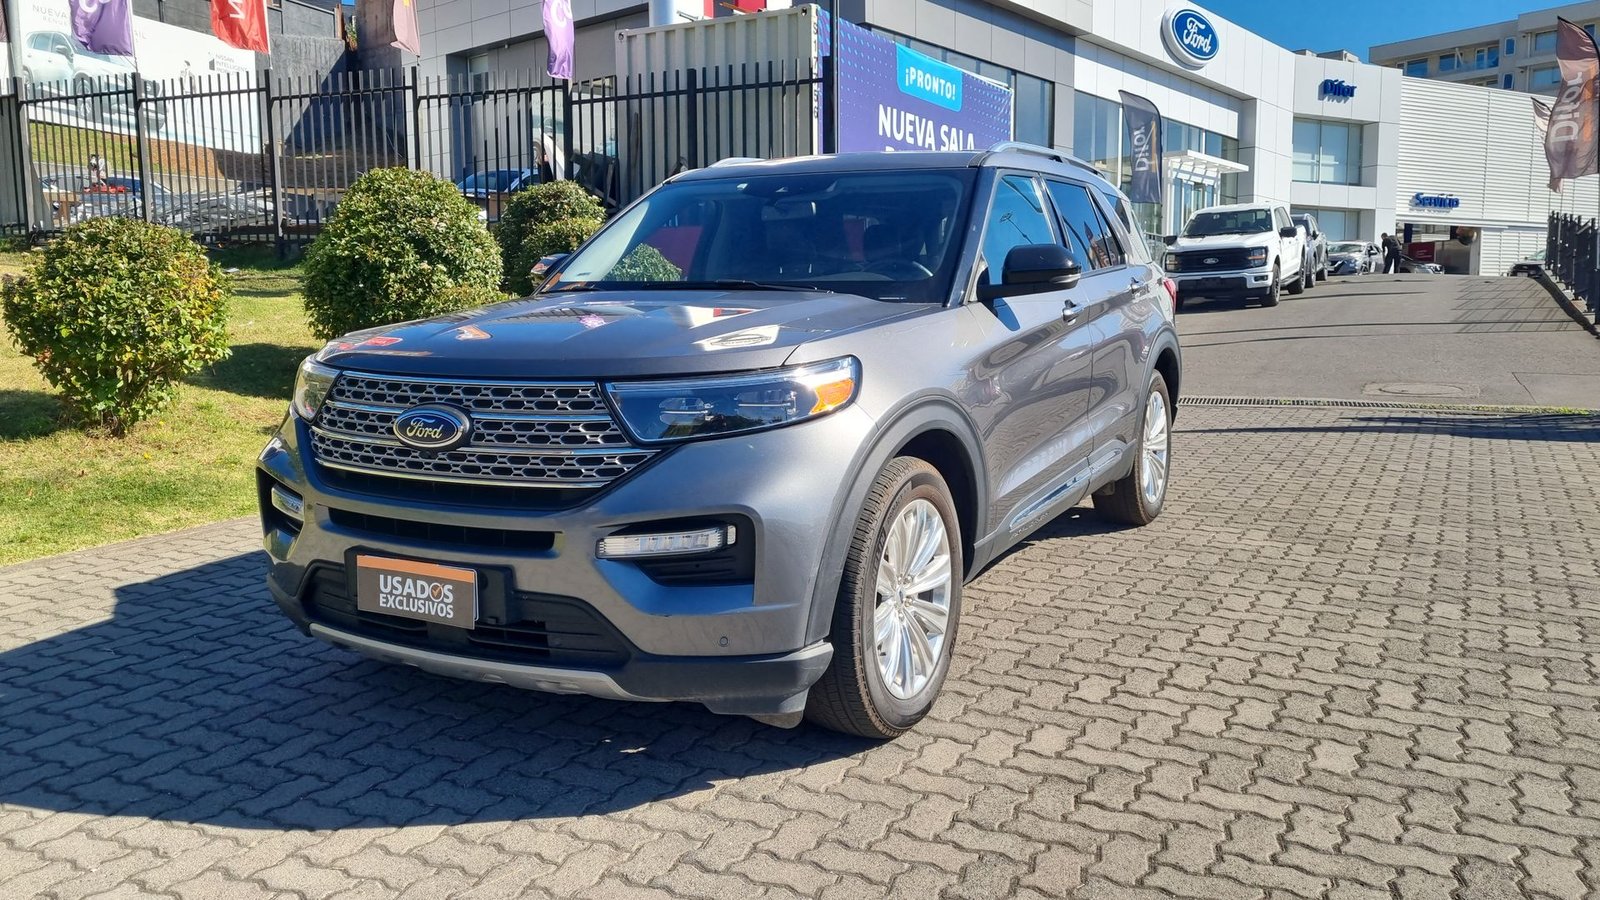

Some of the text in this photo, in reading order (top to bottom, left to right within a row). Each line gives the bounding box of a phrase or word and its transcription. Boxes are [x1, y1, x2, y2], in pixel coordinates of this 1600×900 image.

[32, 4, 67, 18] NUEVA
[1183, 17, 1212, 53] Ford
[905, 66, 956, 101] ¡PRONTO!
[878, 103, 975, 151] NUEVA SALA
[406, 417, 444, 439] Ford
[379, 574, 454, 604] USADOS
[379, 593, 454, 619] EXCLUSIVOS
